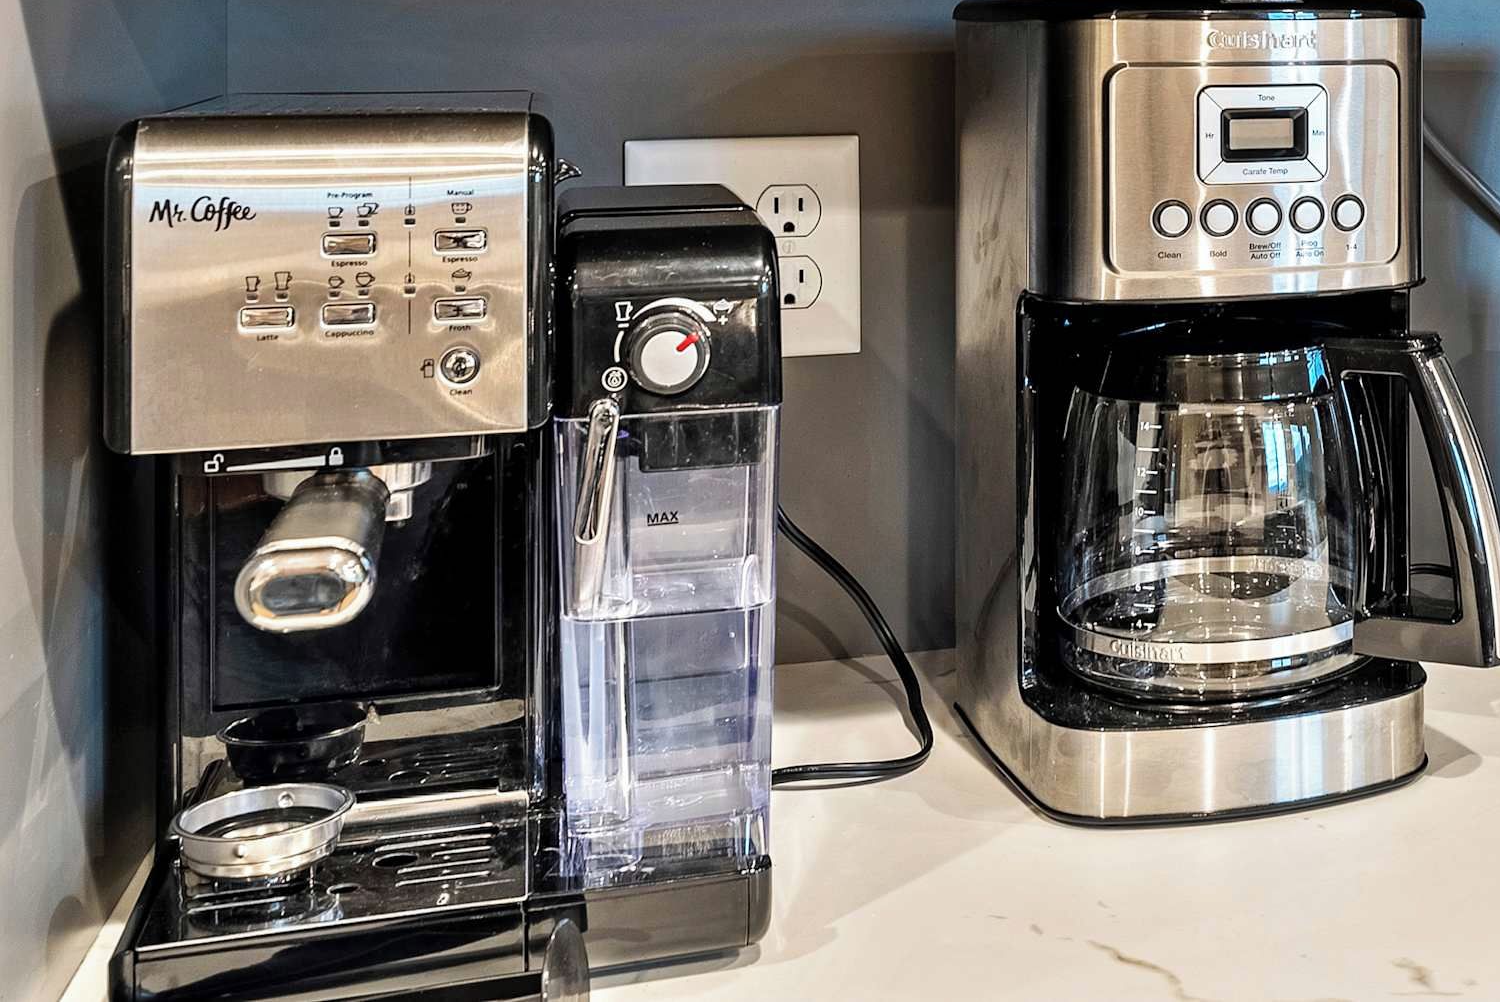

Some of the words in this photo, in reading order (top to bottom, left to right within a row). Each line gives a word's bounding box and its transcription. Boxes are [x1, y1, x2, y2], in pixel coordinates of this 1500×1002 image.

[1207, 29, 1318, 49] Cuisinart
[1242, 167, 1267, 175] Carafe
[1268, 167, 1288, 175] Temp
[327, 191, 373, 199] Pre-Program
[148, 198, 187, 228] Mr.
[190, 195, 257, 232] Coffee
[1249, 241, 1282, 250] Brew/Off
[1157, 251, 1182, 260] Clean
[1209, 250, 1227, 258] Bold
[1250, 252, 1268, 260] Auto
[331, 260, 368, 268] Espresso
[442, 256, 478, 264] Espresso
[449, 324, 472, 332] Froth
[256, 334, 279, 342] Latte
[324, 329, 375, 339] Cappuccino
[1140, 421, 1150, 431] 14
[1136, 467, 1146, 477] 12
[1134, 506, 1144, 516] 10
[646, 510, 679, 524] MAX
[1135, 619, 1143, 629] 4
